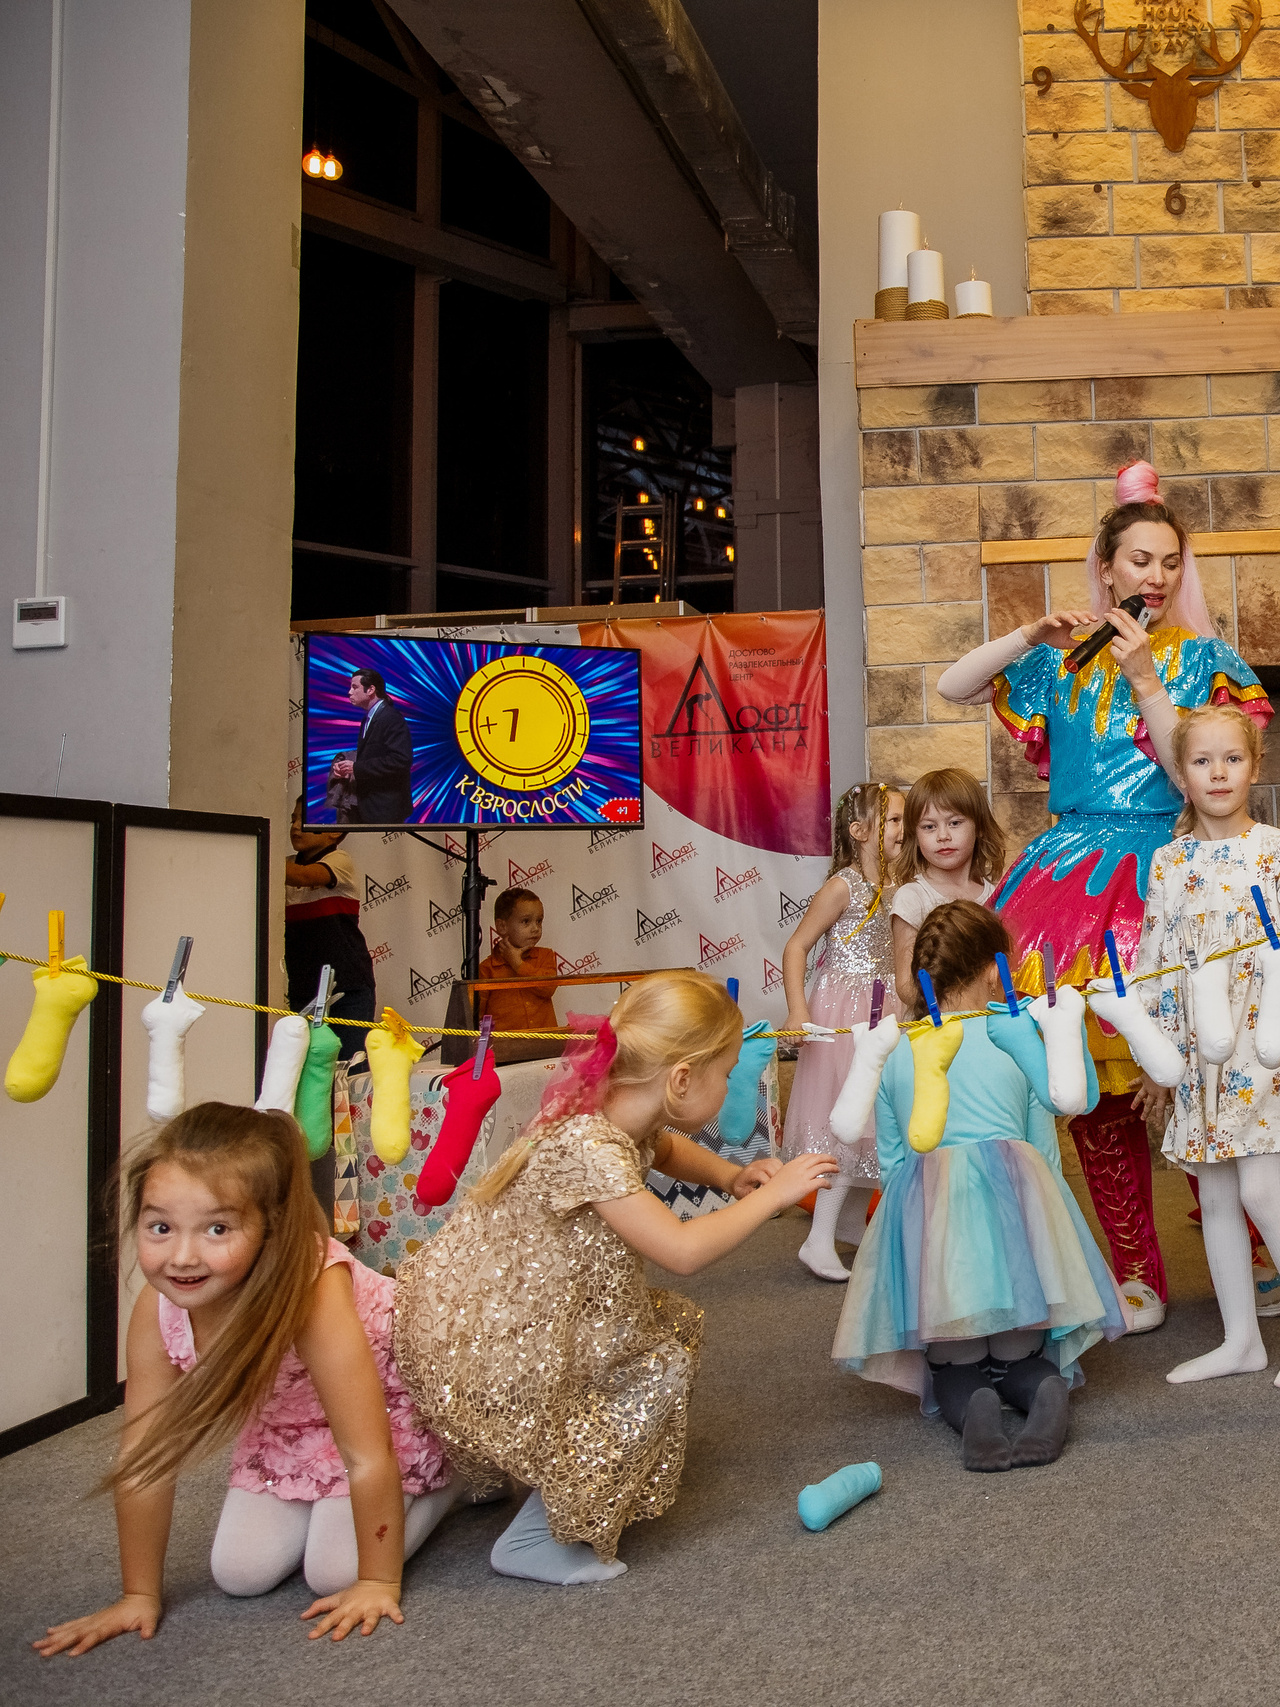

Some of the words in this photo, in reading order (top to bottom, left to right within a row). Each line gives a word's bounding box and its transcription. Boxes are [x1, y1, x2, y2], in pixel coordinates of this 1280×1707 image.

[1143, 7, 1199, 22] HOUR
[1137, 22, 1204, 38] EVERY
[1150, 39, 1188, 55] DAY
[1032, 66, 1053, 96] 9
[1164, 183, 1186, 215] 6
[729, 648, 775, 658] ДОСУГОВО
[729, 657, 804, 669] РАЗВЛЕКАТЕЛЬНЫЙ
[729, 673, 754, 682] ЦЕНТР
[651, 734, 808, 758] ВЕЛИКАНА
[454, 774, 475, 796] К
[470, 777, 591, 818] ВЗРОСЛОСТИ
[651, 851, 699, 879] ВЕЛИКАНА
[518, 868, 555, 889] ЛИКАНА
[715, 876, 763, 904] ВЕЛИКАНА
[363, 885, 412, 912] ВЕЛИКАНА
[571, 893, 620, 921] ВЕЛИКАНА
[426, 900, 463, 932] ЛОФ
[427, 917, 462, 938] ВЕЛИКА
[635, 918, 683, 946] ВЕЛИКАНА
[369, 943, 392, 959] ОФТ
[699, 943, 746, 971] ВЕЛИКАНА
